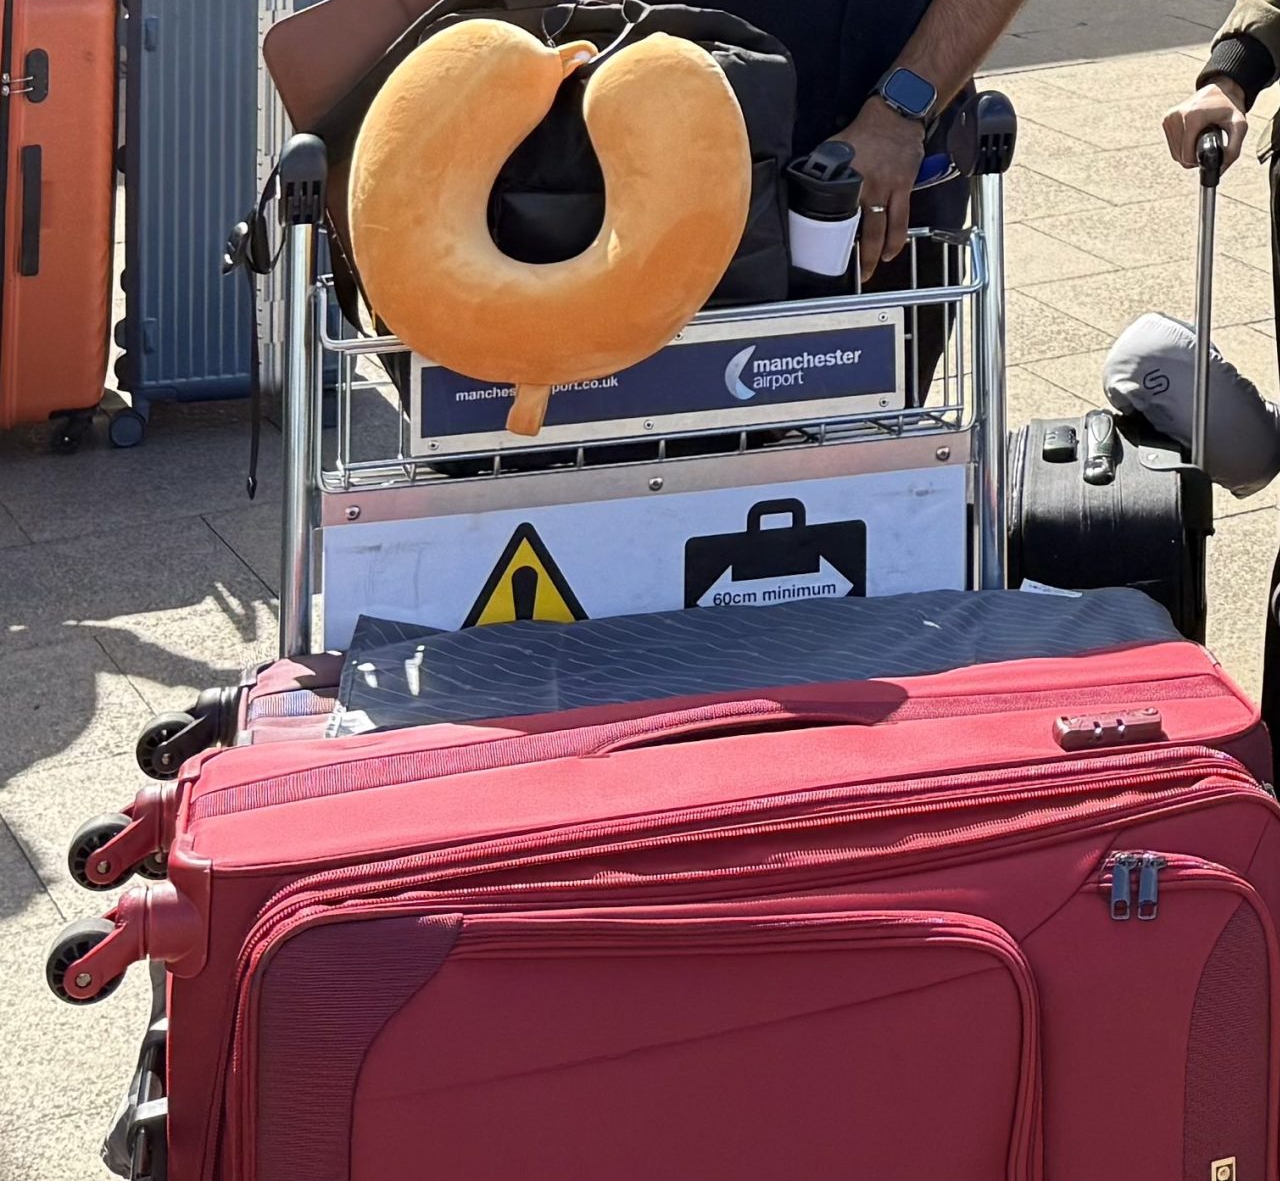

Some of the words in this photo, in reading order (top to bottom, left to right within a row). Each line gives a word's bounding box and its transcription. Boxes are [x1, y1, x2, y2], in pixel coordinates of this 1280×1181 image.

[753, 349, 862, 373] manchester
[753, 369, 804, 390] airport
[713, 591, 757, 606] 60cm
[762, 583, 836, 602] minimum
